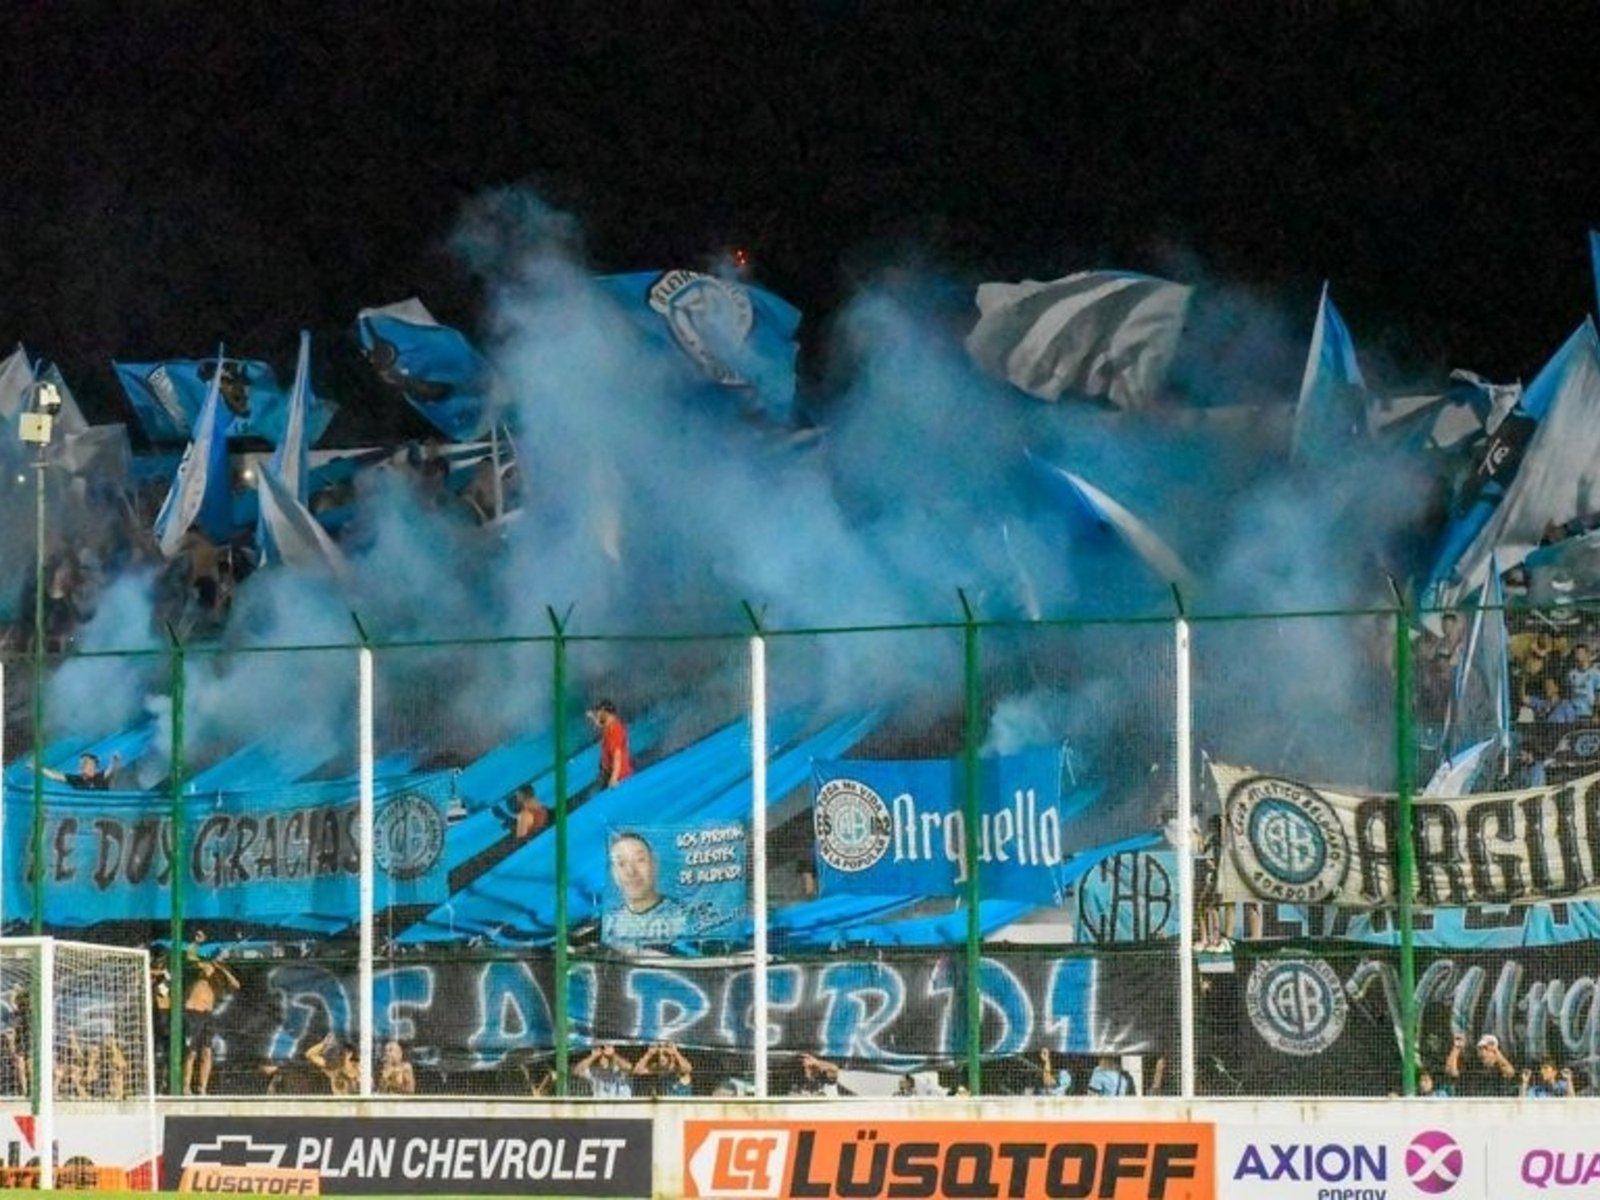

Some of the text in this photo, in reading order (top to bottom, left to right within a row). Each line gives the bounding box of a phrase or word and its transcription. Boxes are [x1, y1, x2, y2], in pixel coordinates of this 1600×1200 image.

[191, 801, 362, 888] GRACIAS
[892, 789, 1062, 885] Arguello
[1354, 780, 1600, 903] ARGU
[295, 1136, 627, 1179] PLAN CHEVROLET
[789, 1130, 1199, 1198] LÜSQTOFF
[1233, 1144, 1387, 1181] AXION
